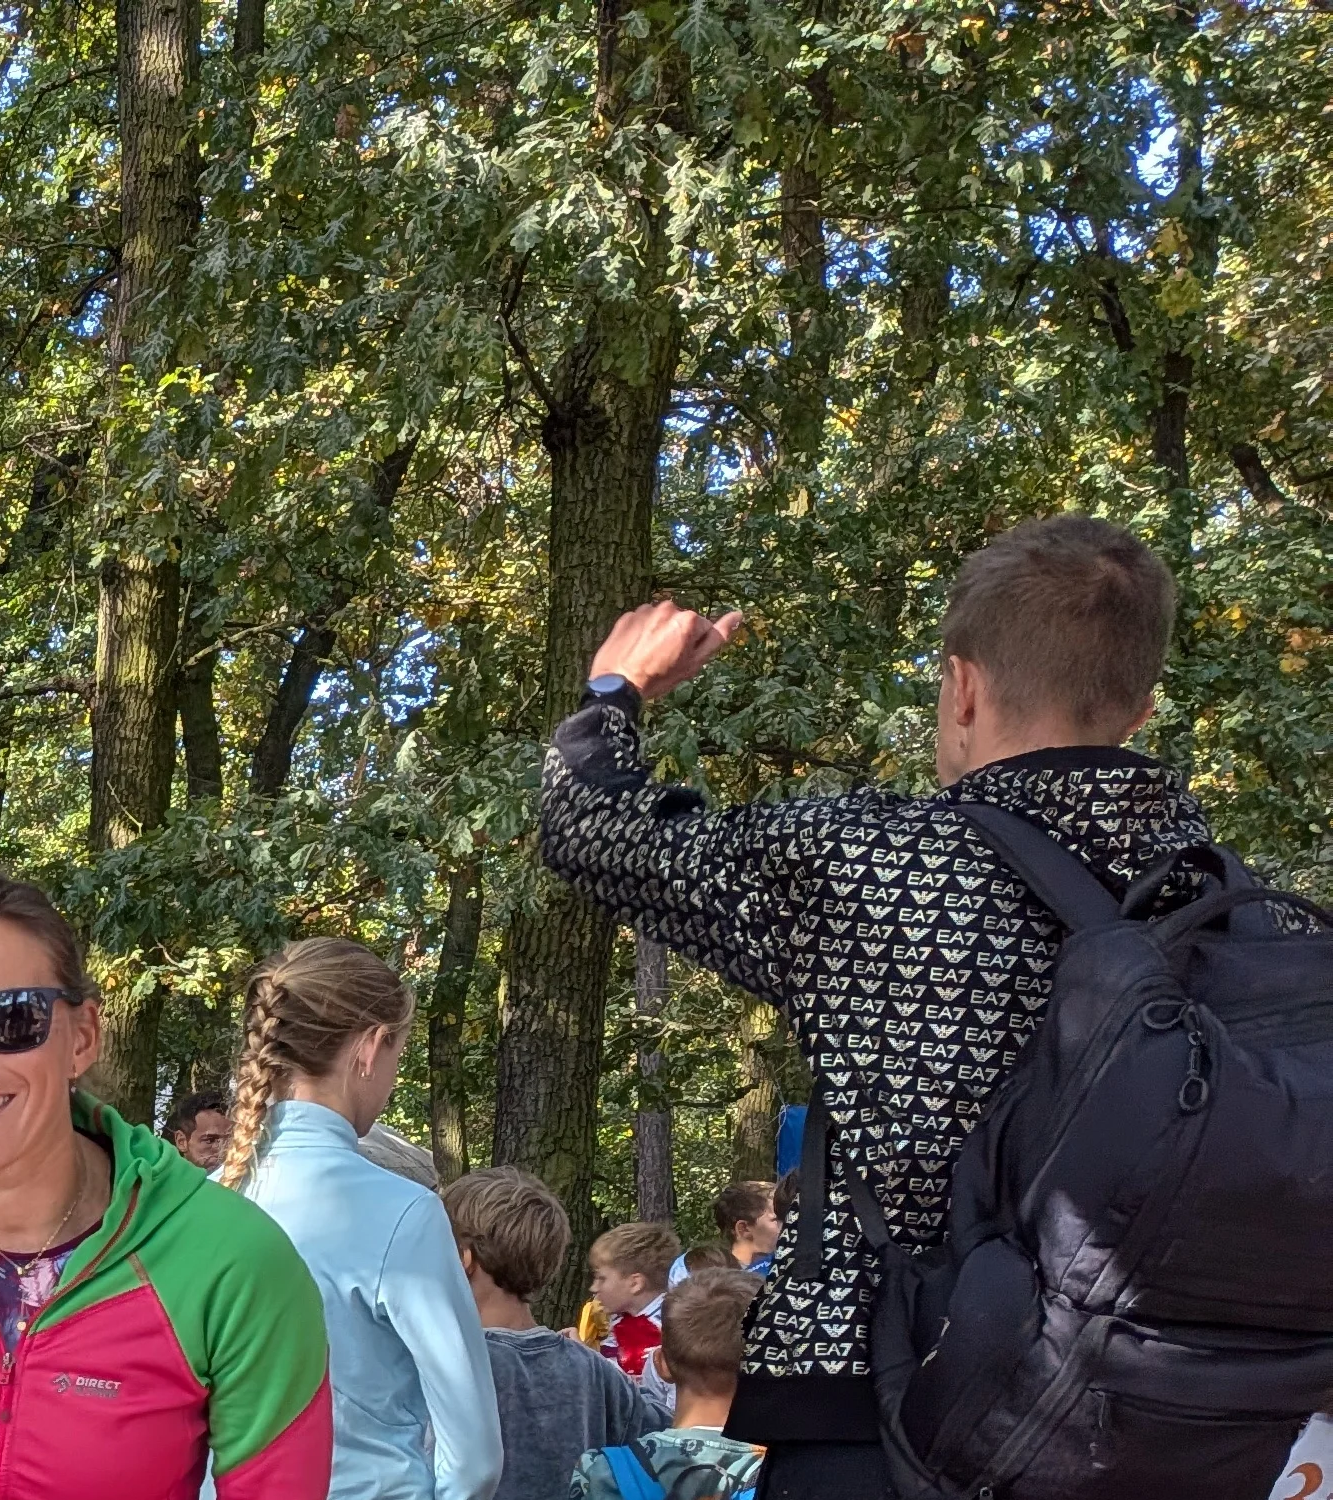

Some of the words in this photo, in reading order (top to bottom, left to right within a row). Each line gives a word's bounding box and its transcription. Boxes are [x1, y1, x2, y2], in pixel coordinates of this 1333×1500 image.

[1092, 801, 1130, 816] EA7
[840, 826, 880, 842] EA7
[884, 819, 926, 833] EA7
[918, 837, 960, 852] EA7
[871, 847, 913, 866] EA7
[827, 861, 868, 879] EA7
[907, 871, 950, 888] EA7
[861, 885, 903, 902] EA7
[944, 893, 986, 909] EA7
[823, 899, 859, 916] EA7
[898, 908, 941, 924] EA7
[856, 922, 894, 939] EA7
[983, 915, 1024, 933] EA7
[819, 936, 854, 953] EA7
[936, 929, 979, 946] EA7
[893, 944, 934, 961] EA7
[1021, 938, 1060, 956] EA7
[793, 953, 817, 969] A7
[853, 960, 889, 977] EA7
[976, 952, 1019, 969] EA7
[817, 974, 852, 991] EA7
[930, 967, 973, 984] EA7
[888, 982, 928, 999] EA7
[1015, 976, 1053, 994] EA7
[850, 997, 886, 1014] EA7
[971, 989, 1012, 1007] EA7
[925, 1004, 968, 1021] EA7
[885, 1020, 923, 1036] EA7
[965, 1027, 1007, 1045] EA7
[848, 1034, 881, 1050] EA7
[920, 1042, 962, 1059] EA7
[882, 1055, 917, 1071] EA7
[958, 1065, 999, 1083] EA7
[917, 1077, 956, 1094] EA7
[912, 1114, 953, 1131] EA7
[840, 1128, 863, 1143] A7
[909, 1177, 948, 1193] EA7
[825, 1210, 849, 1226] A7
[904, 1212, 943, 1227] EA7
[785, 1277, 825, 1296] EA7
[817, 1304, 856, 1320] EA7
[773, 1312, 812, 1331] EA7
[815, 1342, 853, 1357] EA7
[76, 1376, 121, 1390] DIRECT
